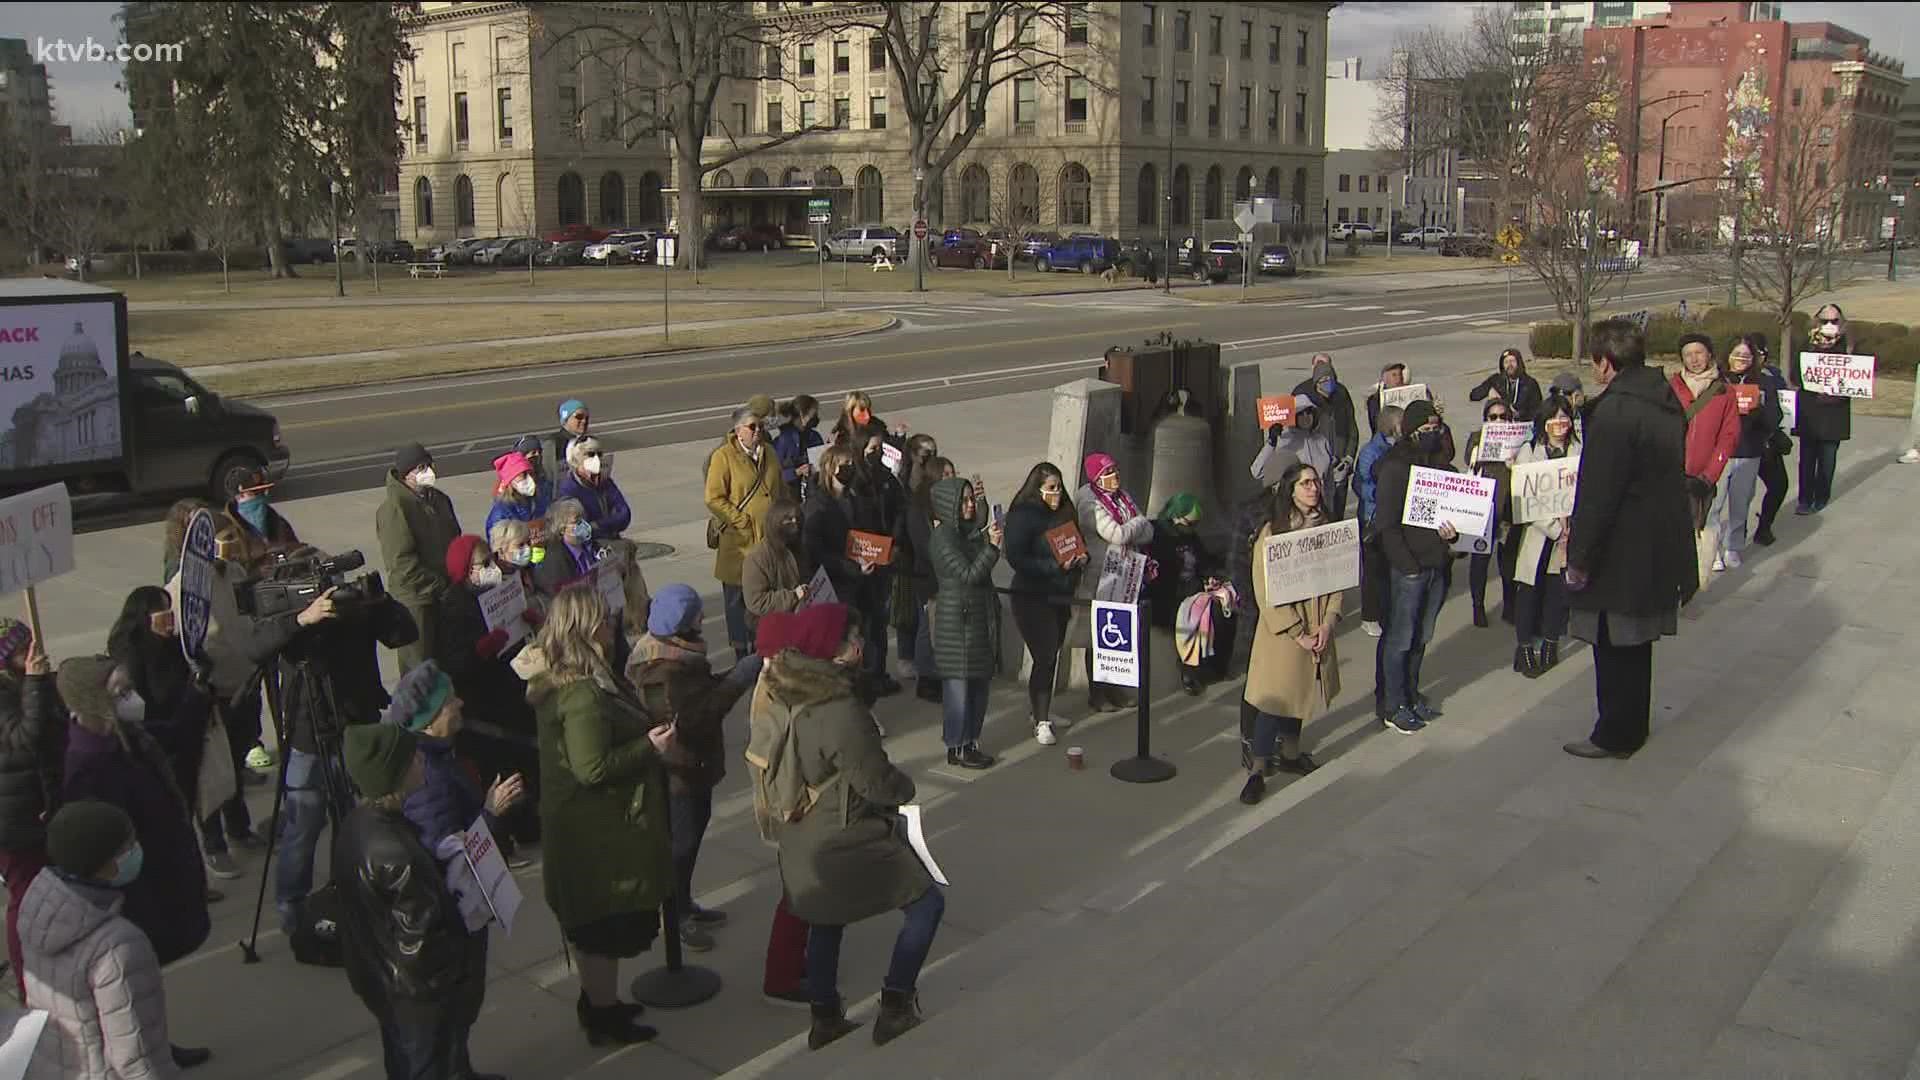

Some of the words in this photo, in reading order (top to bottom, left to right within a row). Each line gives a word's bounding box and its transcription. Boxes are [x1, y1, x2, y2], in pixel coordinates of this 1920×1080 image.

[1818, 355, 1852, 366] KEEP
[1805, 367, 1871, 380] ABORTION
[1831, 386, 1872, 396] LEGAL
[1445, 476, 1481, 488] PROTECT
[1523, 472, 1553, 498] NO
[1416, 480, 1457, 492] ABORTION
[1459, 487, 1489, 497] ACCESS
[1268, 541, 1293, 562] MY
[1097, 653, 1134, 664] Reserved
[1100, 664, 1131, 673] Section
